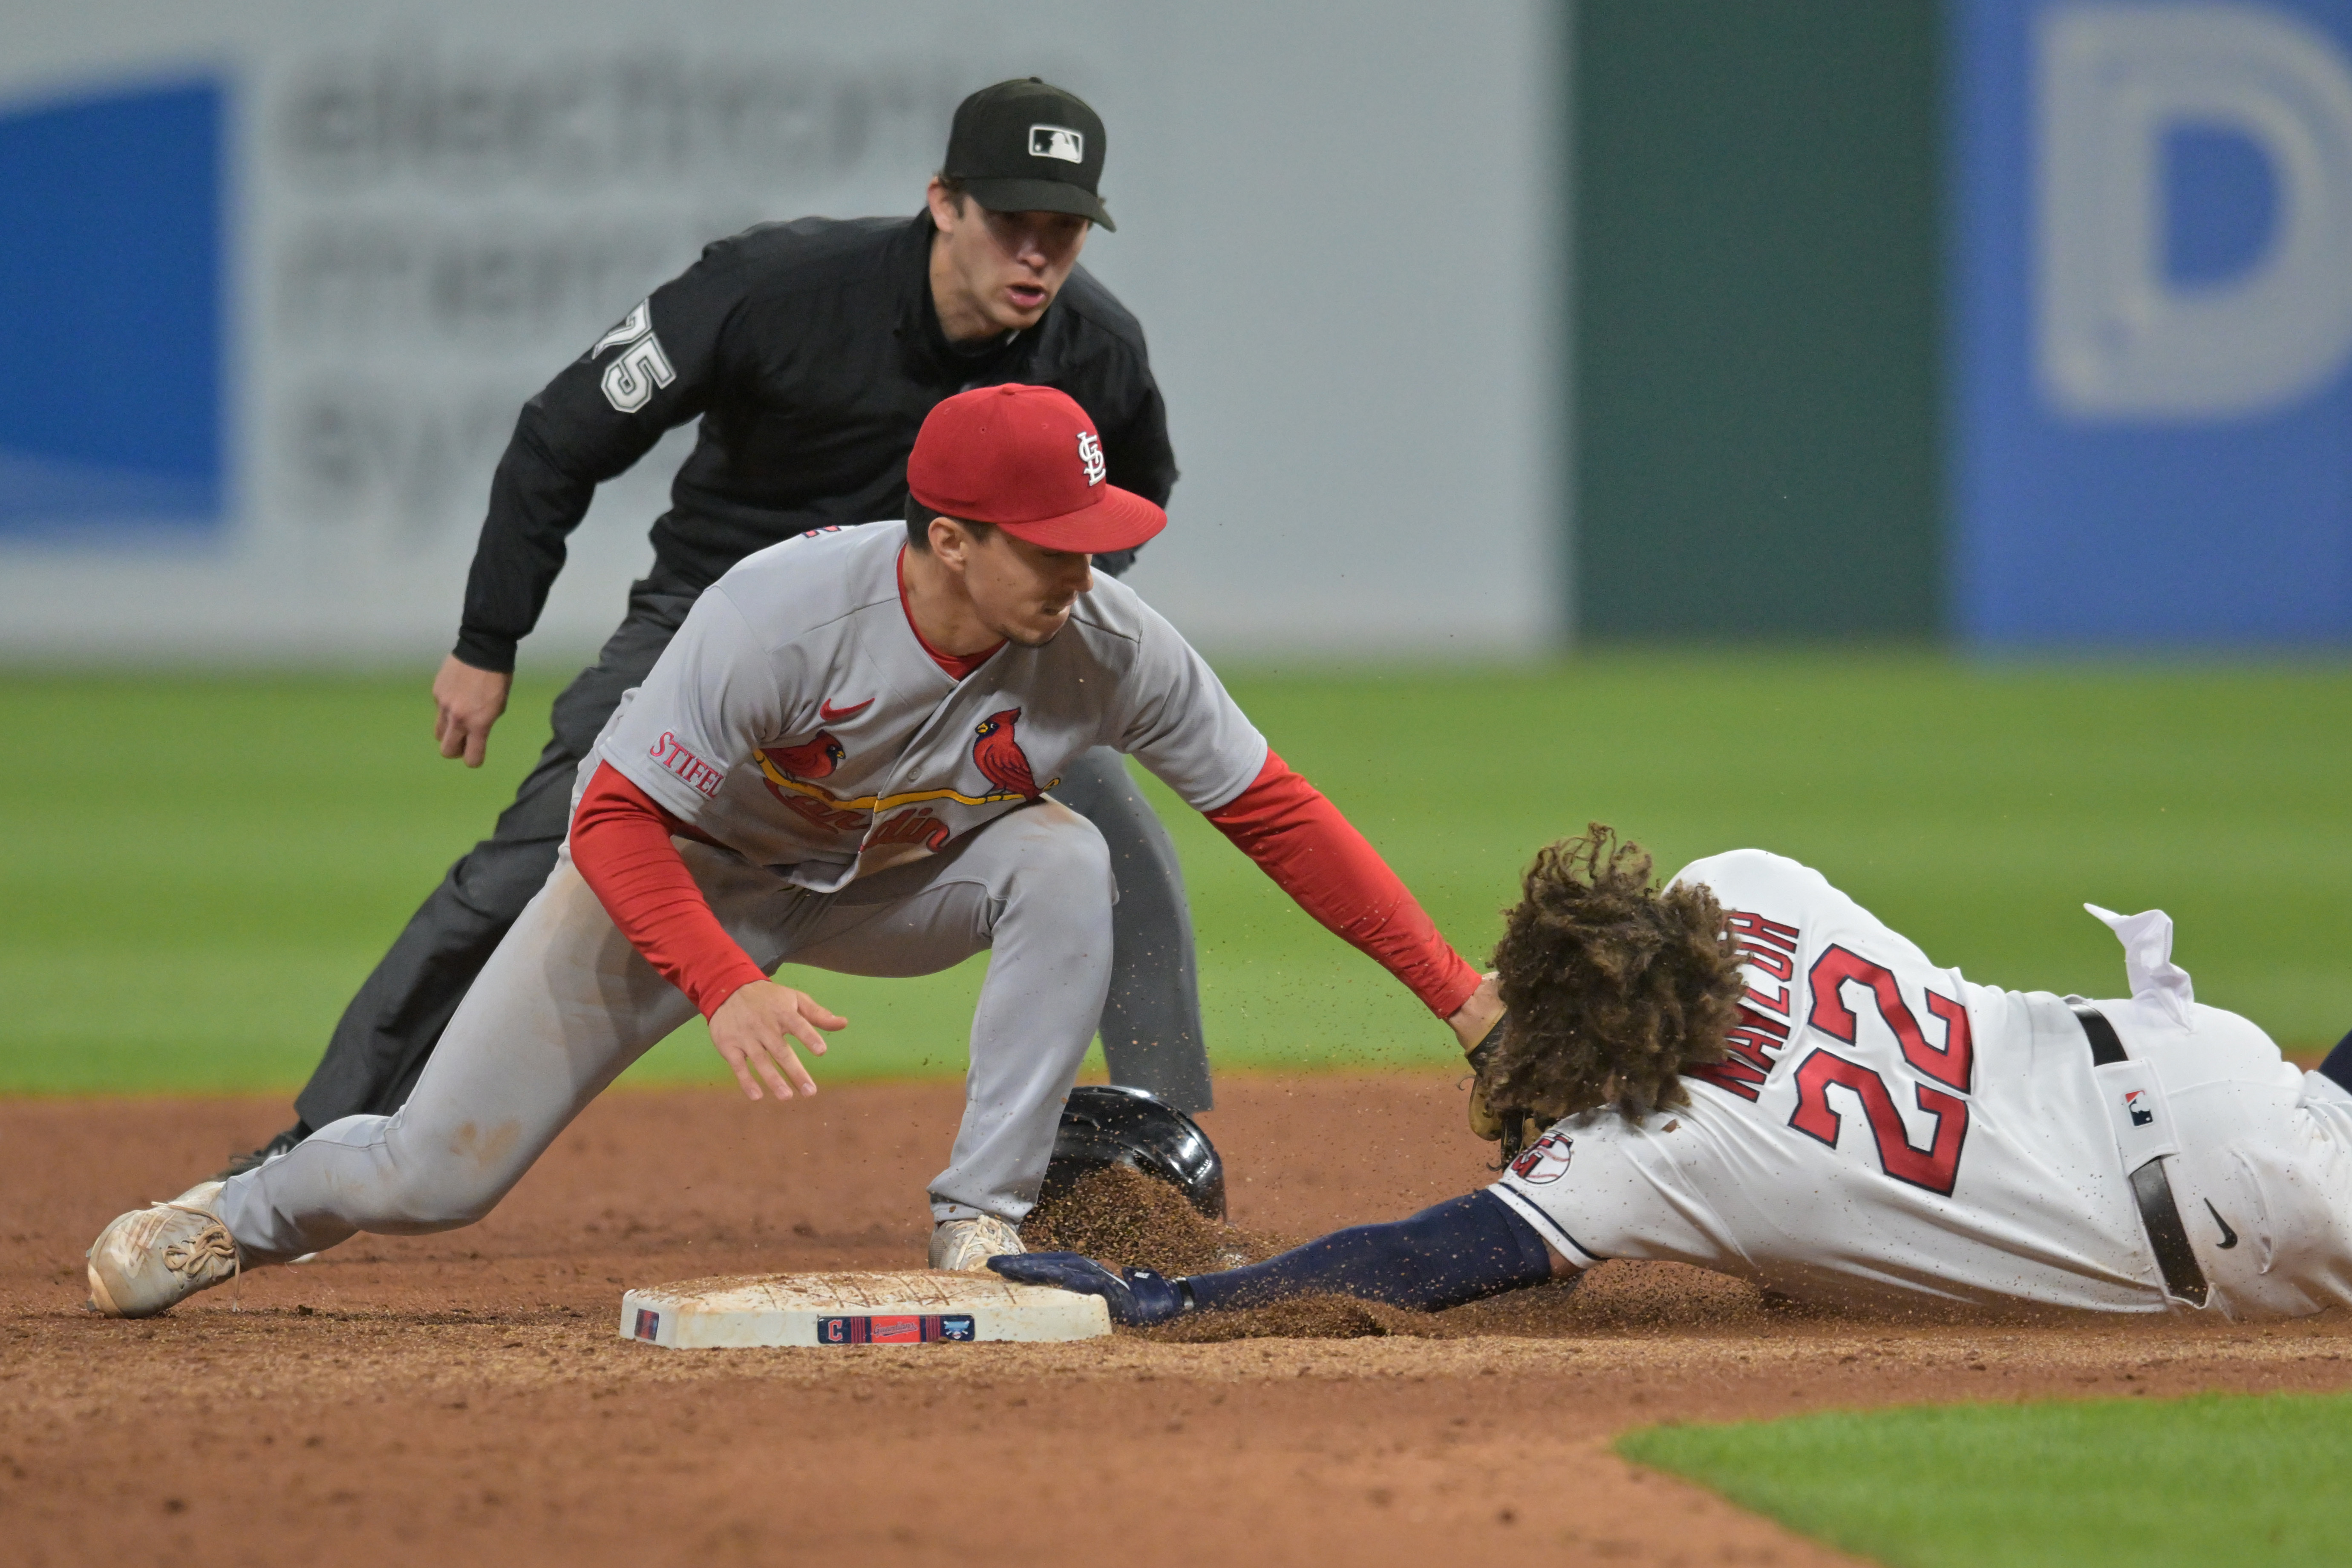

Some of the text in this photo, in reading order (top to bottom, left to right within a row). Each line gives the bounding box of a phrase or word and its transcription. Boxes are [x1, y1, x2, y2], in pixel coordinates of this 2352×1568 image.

[592, 297, 677, 413] 75
[650, 732, 724, 798] STIFEL
[1787, 943, 1973, 1198] 22
[873, 1321, 918, 1338] Guardians
